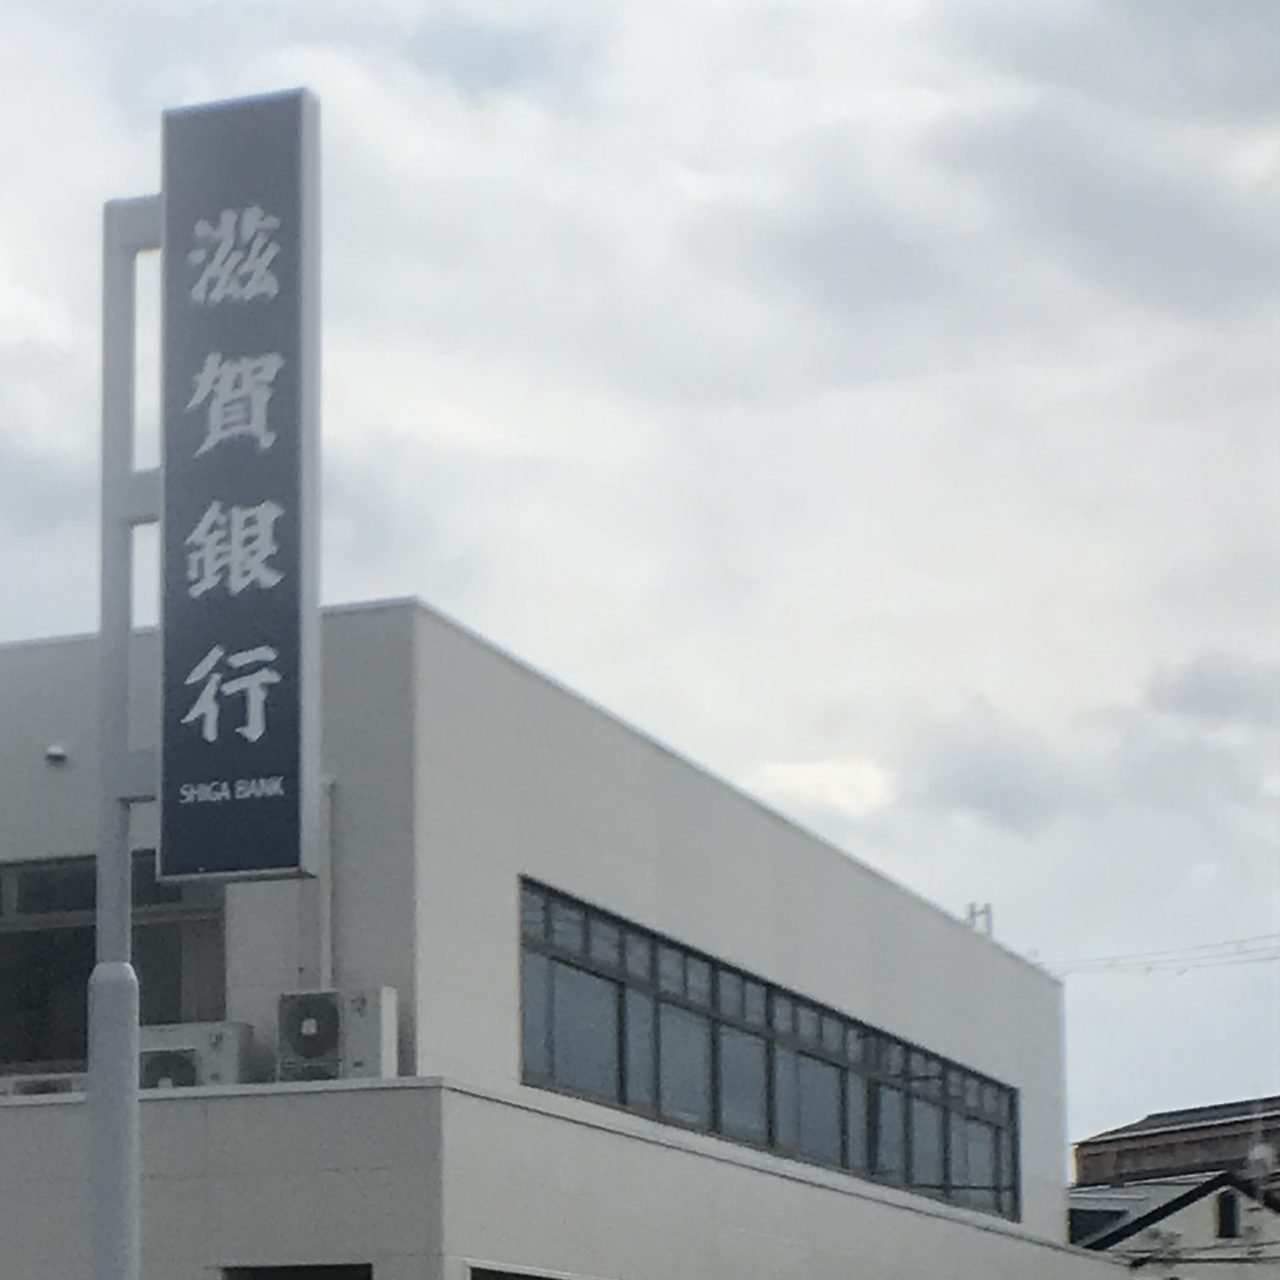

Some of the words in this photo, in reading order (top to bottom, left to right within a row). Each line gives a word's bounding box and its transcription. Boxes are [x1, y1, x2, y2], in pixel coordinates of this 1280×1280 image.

[180, 205, 286, 743] 滋賀銀行
[179, 782, 231, 803] SHIGA
[234, 775, 285, 799] BANK
